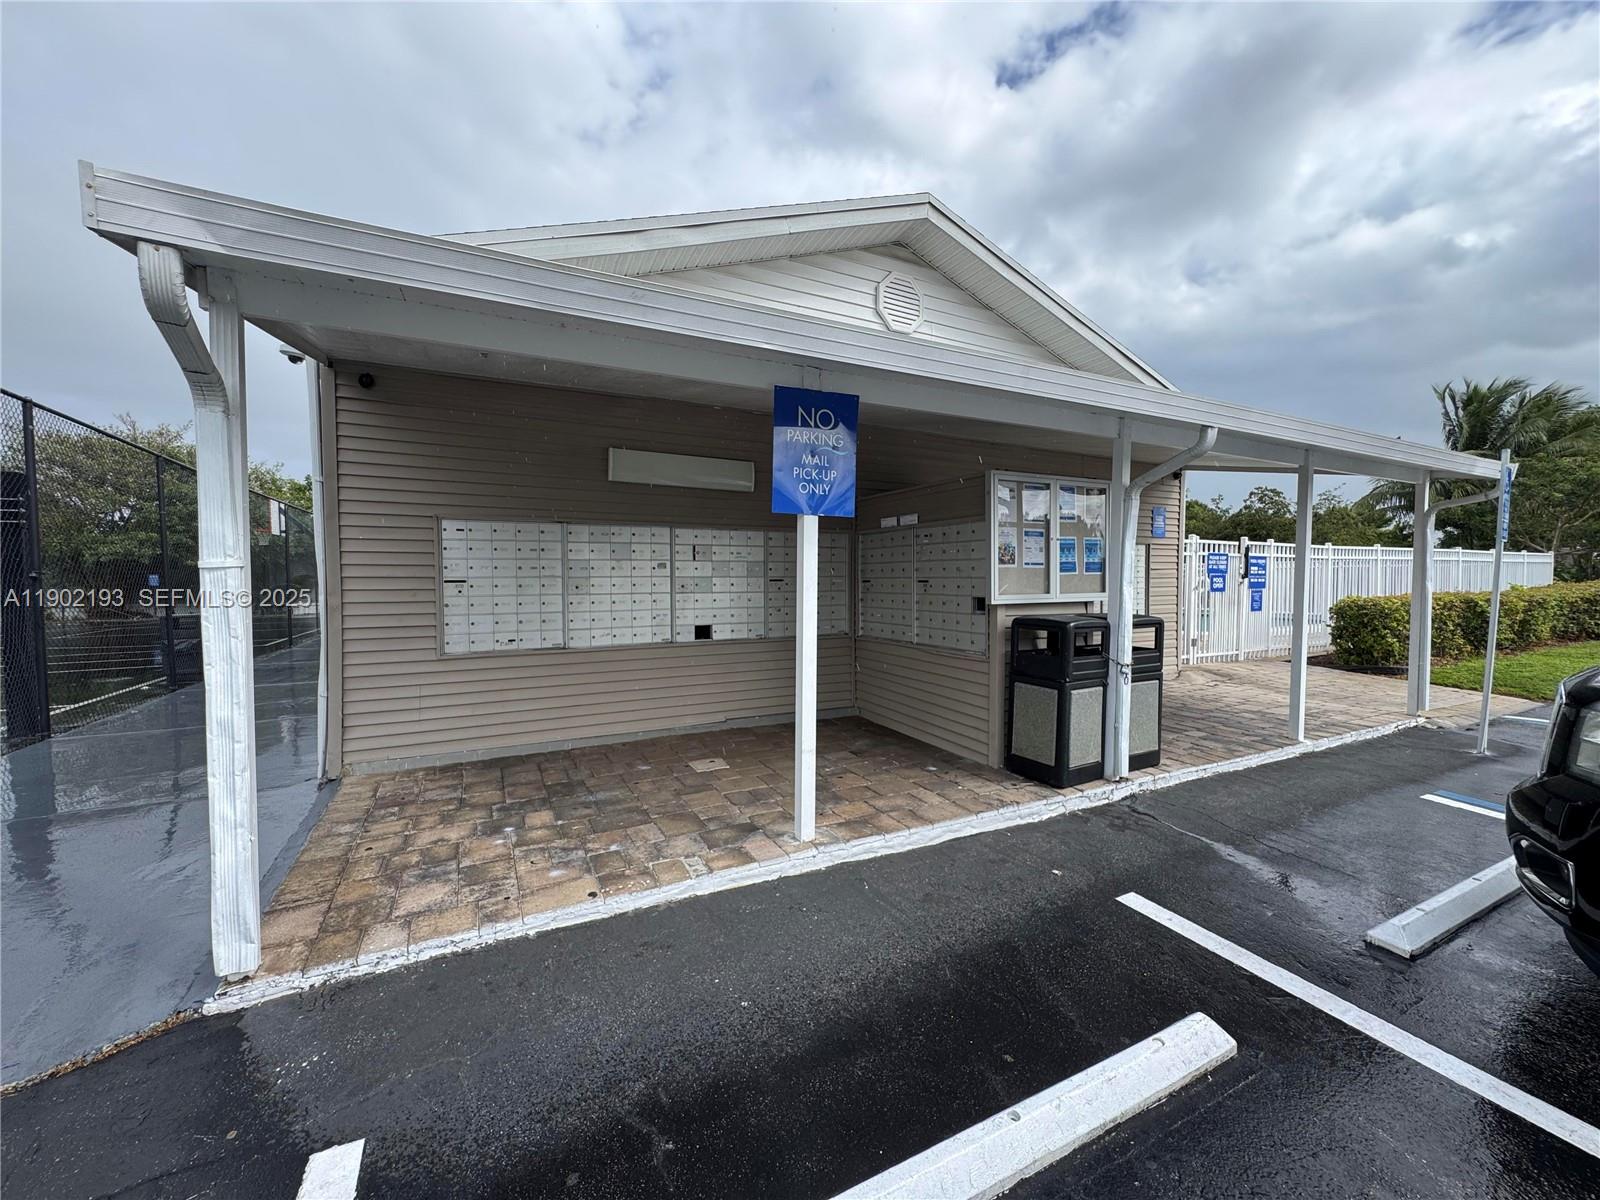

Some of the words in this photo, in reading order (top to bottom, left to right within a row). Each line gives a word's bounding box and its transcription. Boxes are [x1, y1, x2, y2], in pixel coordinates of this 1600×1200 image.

[798, 405, 835, 430] NO
[787, 429, 844, 447] PARKING
[801, 454, 830, 467] MAIL
[793, 467, 837, 481] PICK-UP
[798, 482, 831, 495] ONLY
